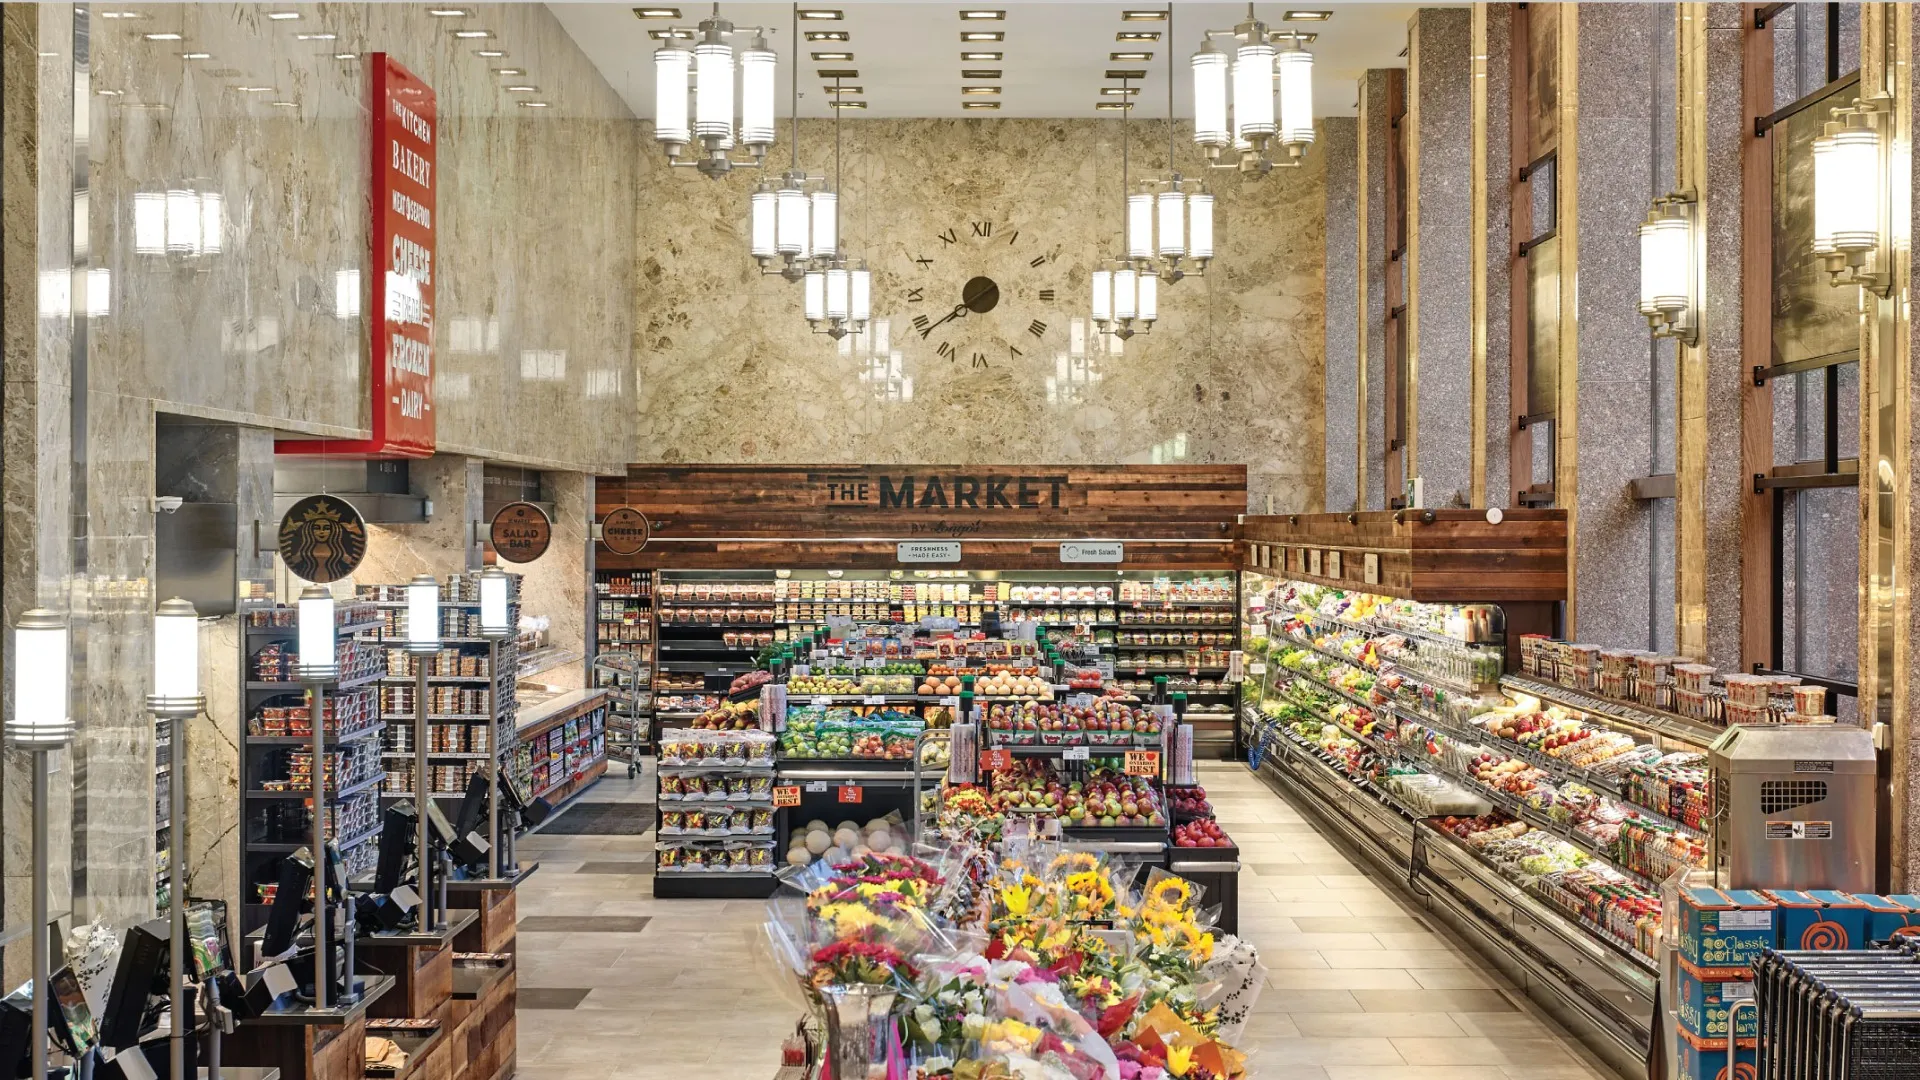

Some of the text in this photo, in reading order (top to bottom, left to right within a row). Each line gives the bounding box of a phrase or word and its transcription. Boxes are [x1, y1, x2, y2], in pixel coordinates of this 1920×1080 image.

[401, 108, 431, 145] KITCHEN
[392, 139, 430, 189] BAKERY
[971, 221, 992, 237] XII
[392, 233, 431, 285] CHEESE
[916, 254, 934, 269] X
[1039, 289, 1055, 301] III
[392, 333, 430, 377] FROZEN
[827, 475, 1069, 509] THE MARKET
[503, 529, 539, 538] SALAD
[931, 519, 981, 537] Longo's
[509, 539, 532, 548] BAR
[1129, 752, 1145, 761] WE
[1129, 765, 1156, 773] BEST
[1724, 935, 1769, 950] Classic
